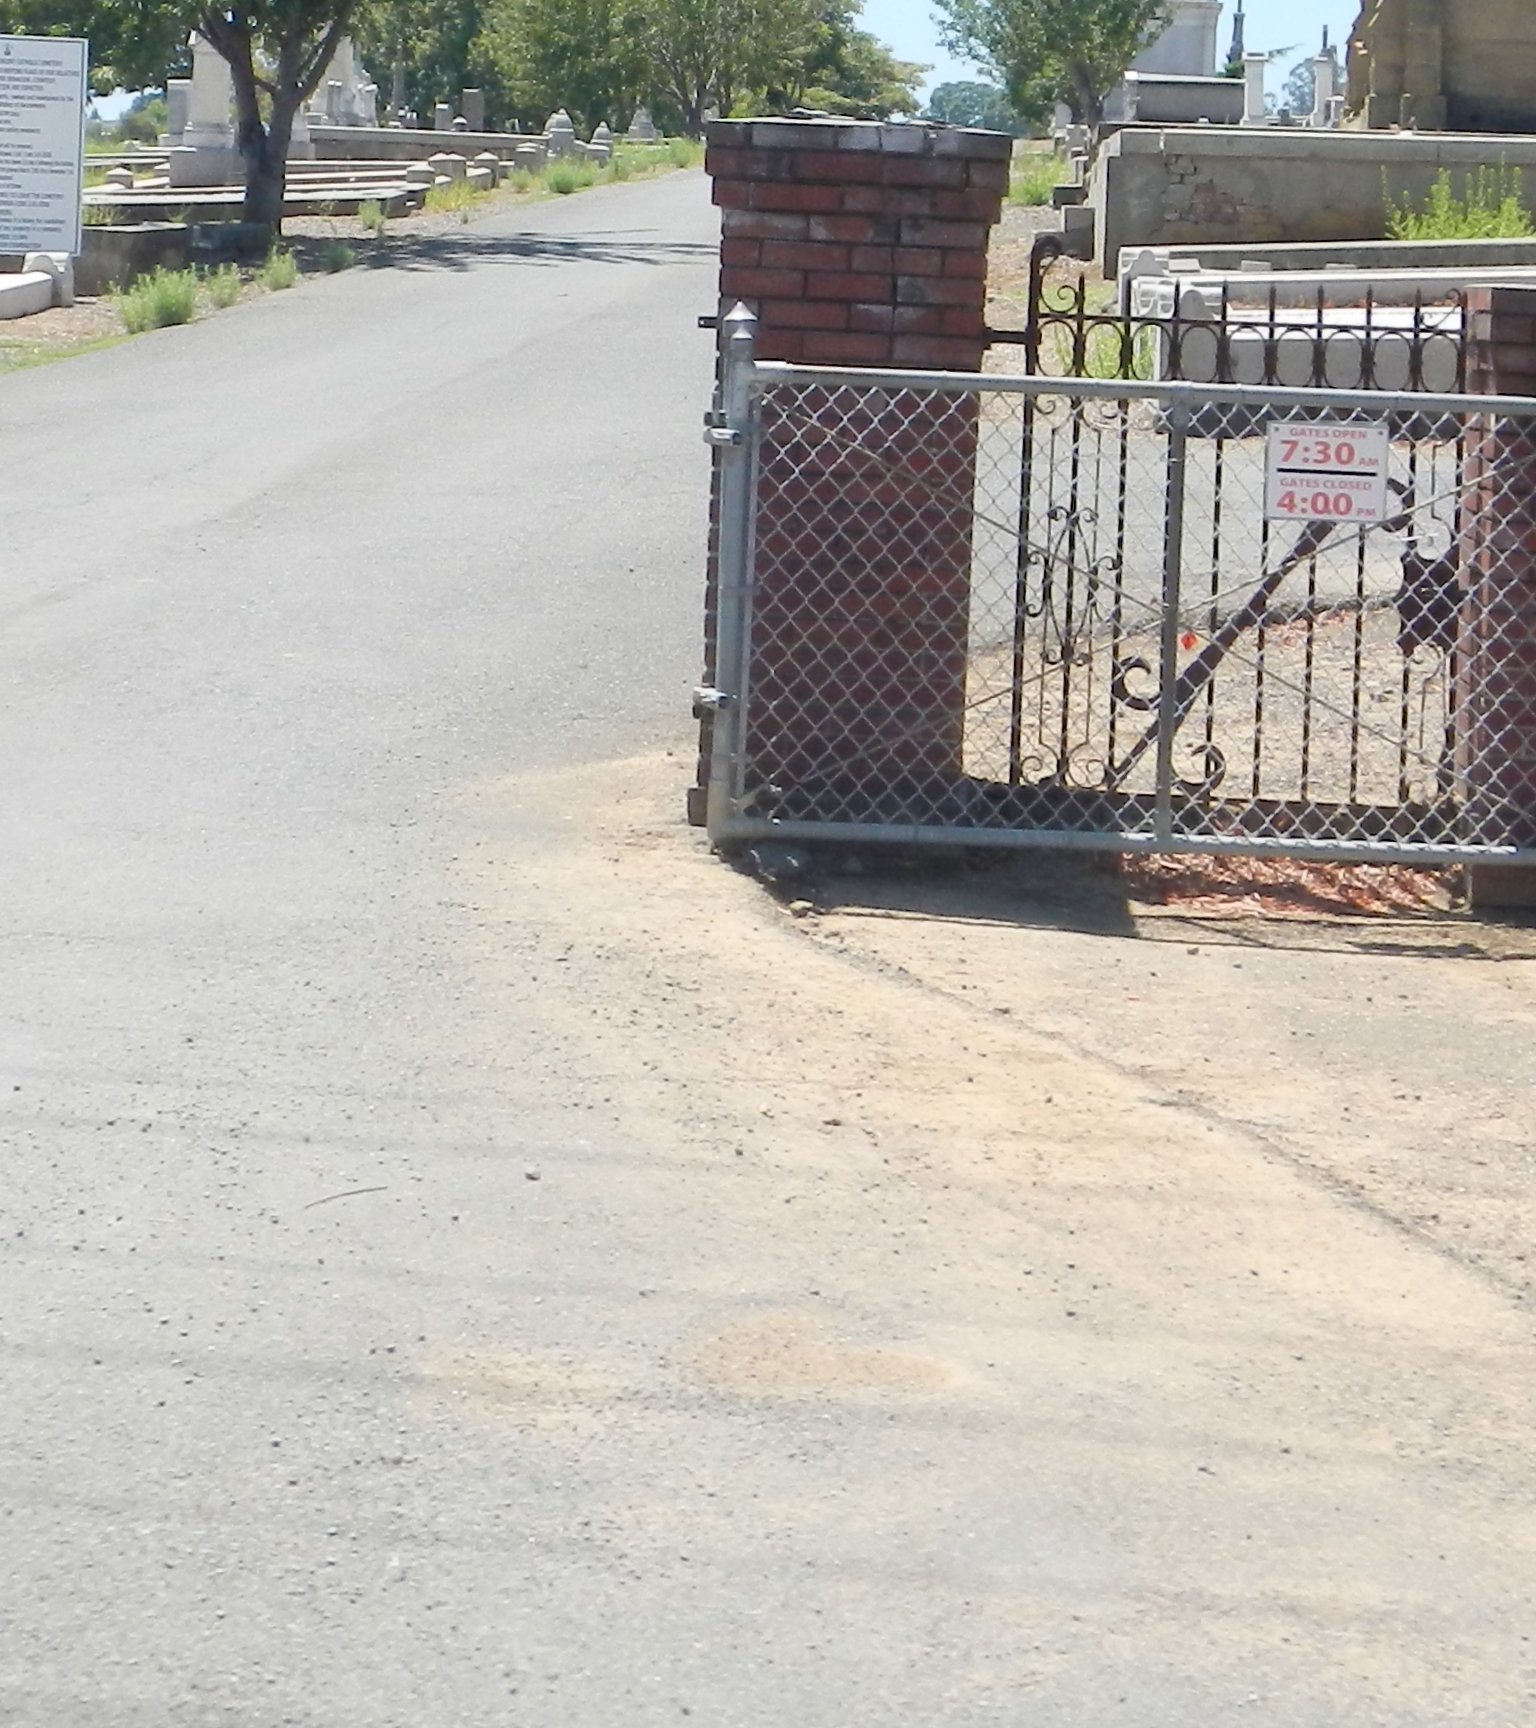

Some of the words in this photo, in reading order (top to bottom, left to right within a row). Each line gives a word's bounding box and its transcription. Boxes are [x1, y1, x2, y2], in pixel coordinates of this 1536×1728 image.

[1290, 428, 1329, 438] GATES
[1332, 429, 1367, 439] OPEN
[1279, 439, 1356, 465] 7:30
[1359, 457, 1379, 467] AM
[1280, 478, 1320, 488] GATES
[1323, 479, 1372, 491] CLOSED
[1276, 490, 1353, 516] 4:00
[1357, 507, 1376, 517] PM
